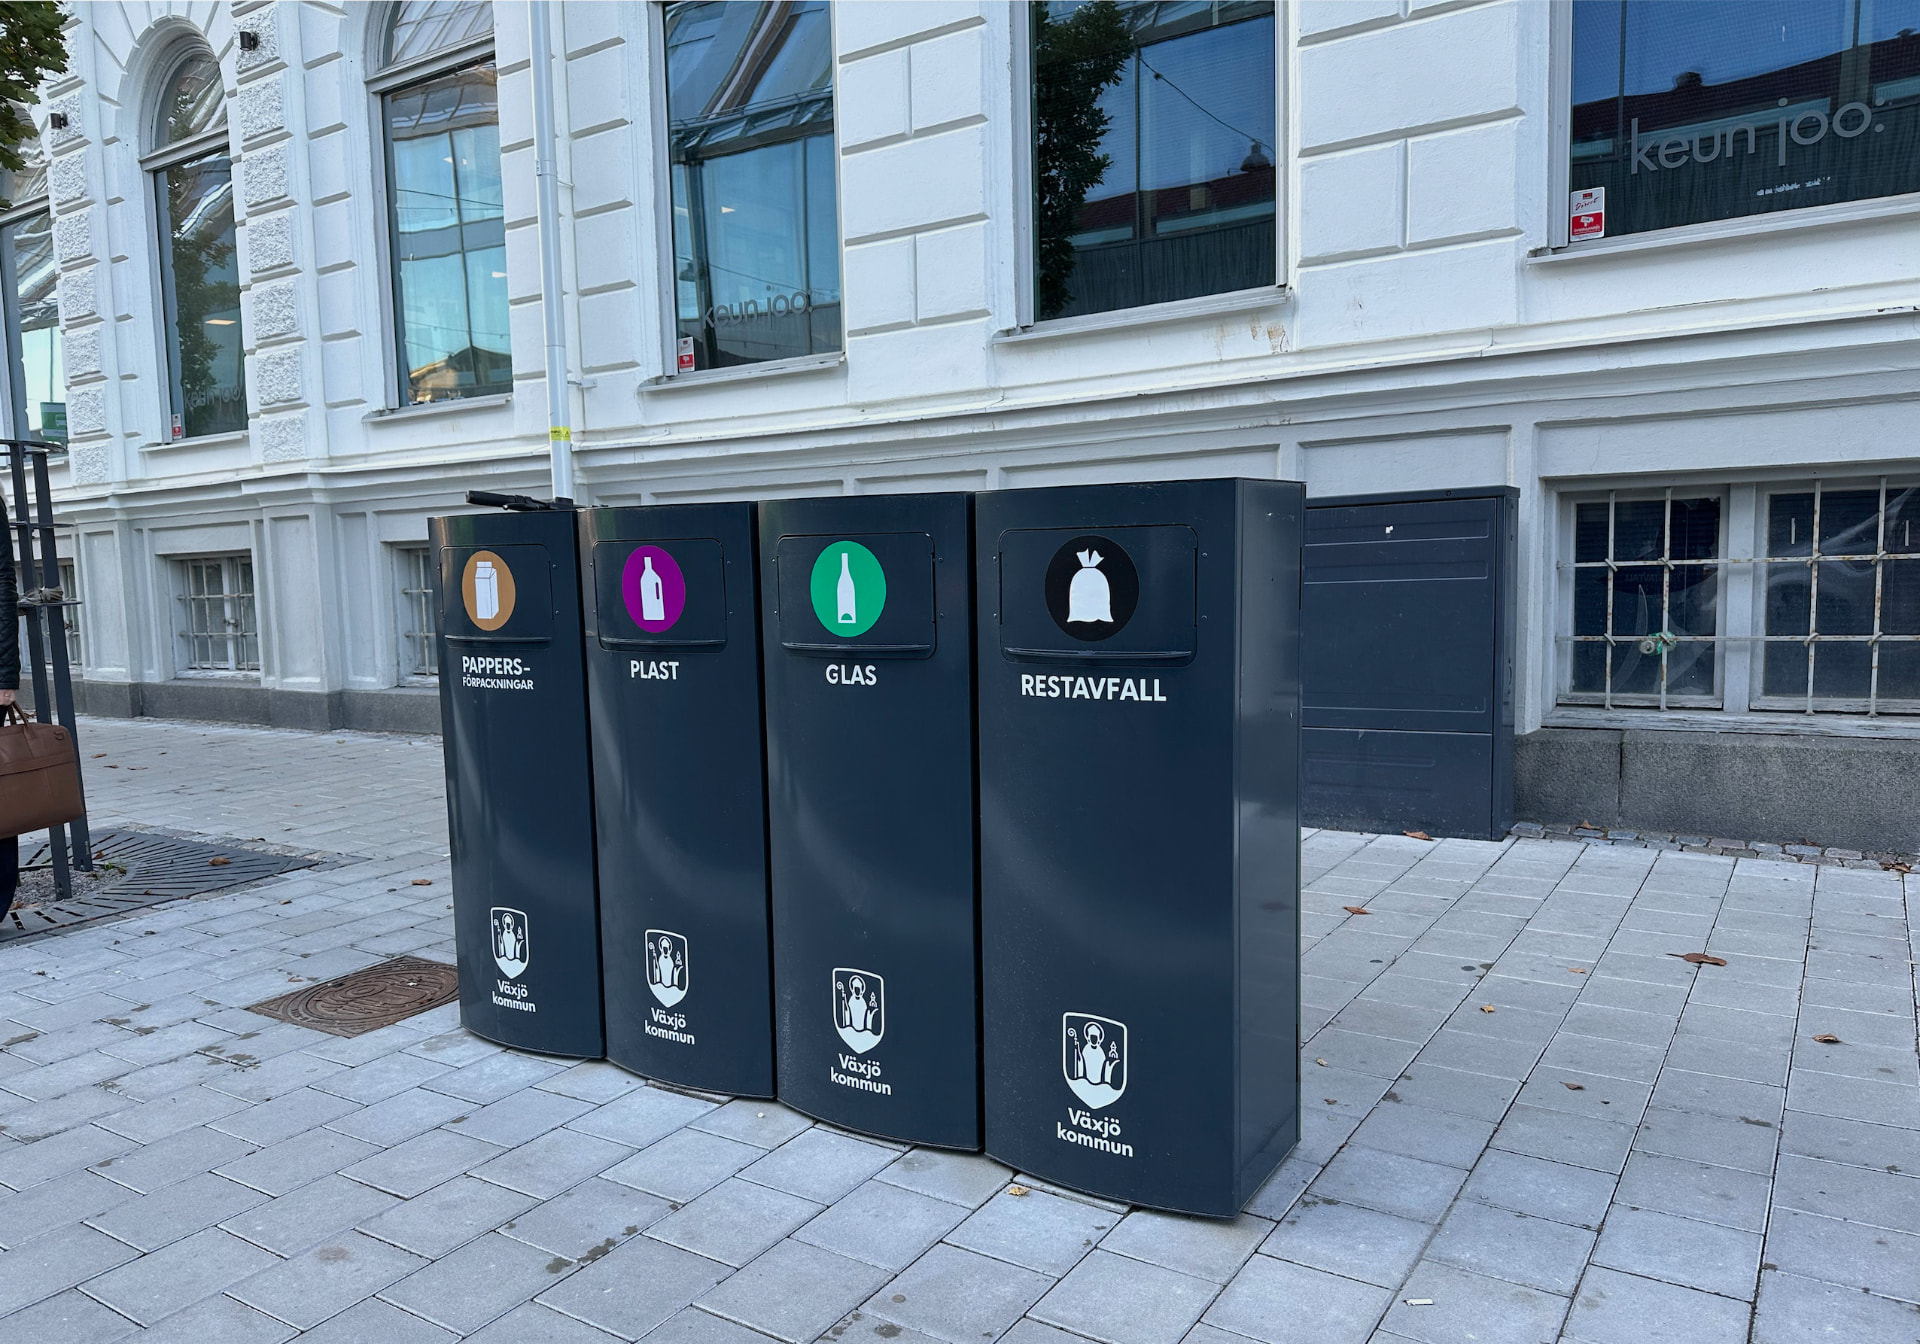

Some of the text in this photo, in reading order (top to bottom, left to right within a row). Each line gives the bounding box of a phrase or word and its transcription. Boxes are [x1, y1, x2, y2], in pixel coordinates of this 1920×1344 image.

[1630, 97, 1885, 175] keun joo:
[701, 290, 759, 329] keun
[462, 656, 531, 676] PAPPERS-
[630, 659, 680, 681] PLAST
[825, 663, 878, 687] GLAS
[462, 674, 534, 690] FÖRPACKNINGAR
[1020, 673, 1168, 703] RESTAVFALL
[491, 990, 537, 1013] kommun
[497, 979, 528, 1000] Växjö
[651, 1007, 687, 1031] Växjö
[644, 1020, 695, 1045] kommun
[838, 1053, 882, 1079] Växjö
[830, 1066, 892, 1096] kommun
[1067, 1107, 1122, 1138] Växjö
[1057, 1121, 1134, 1157] kommun
